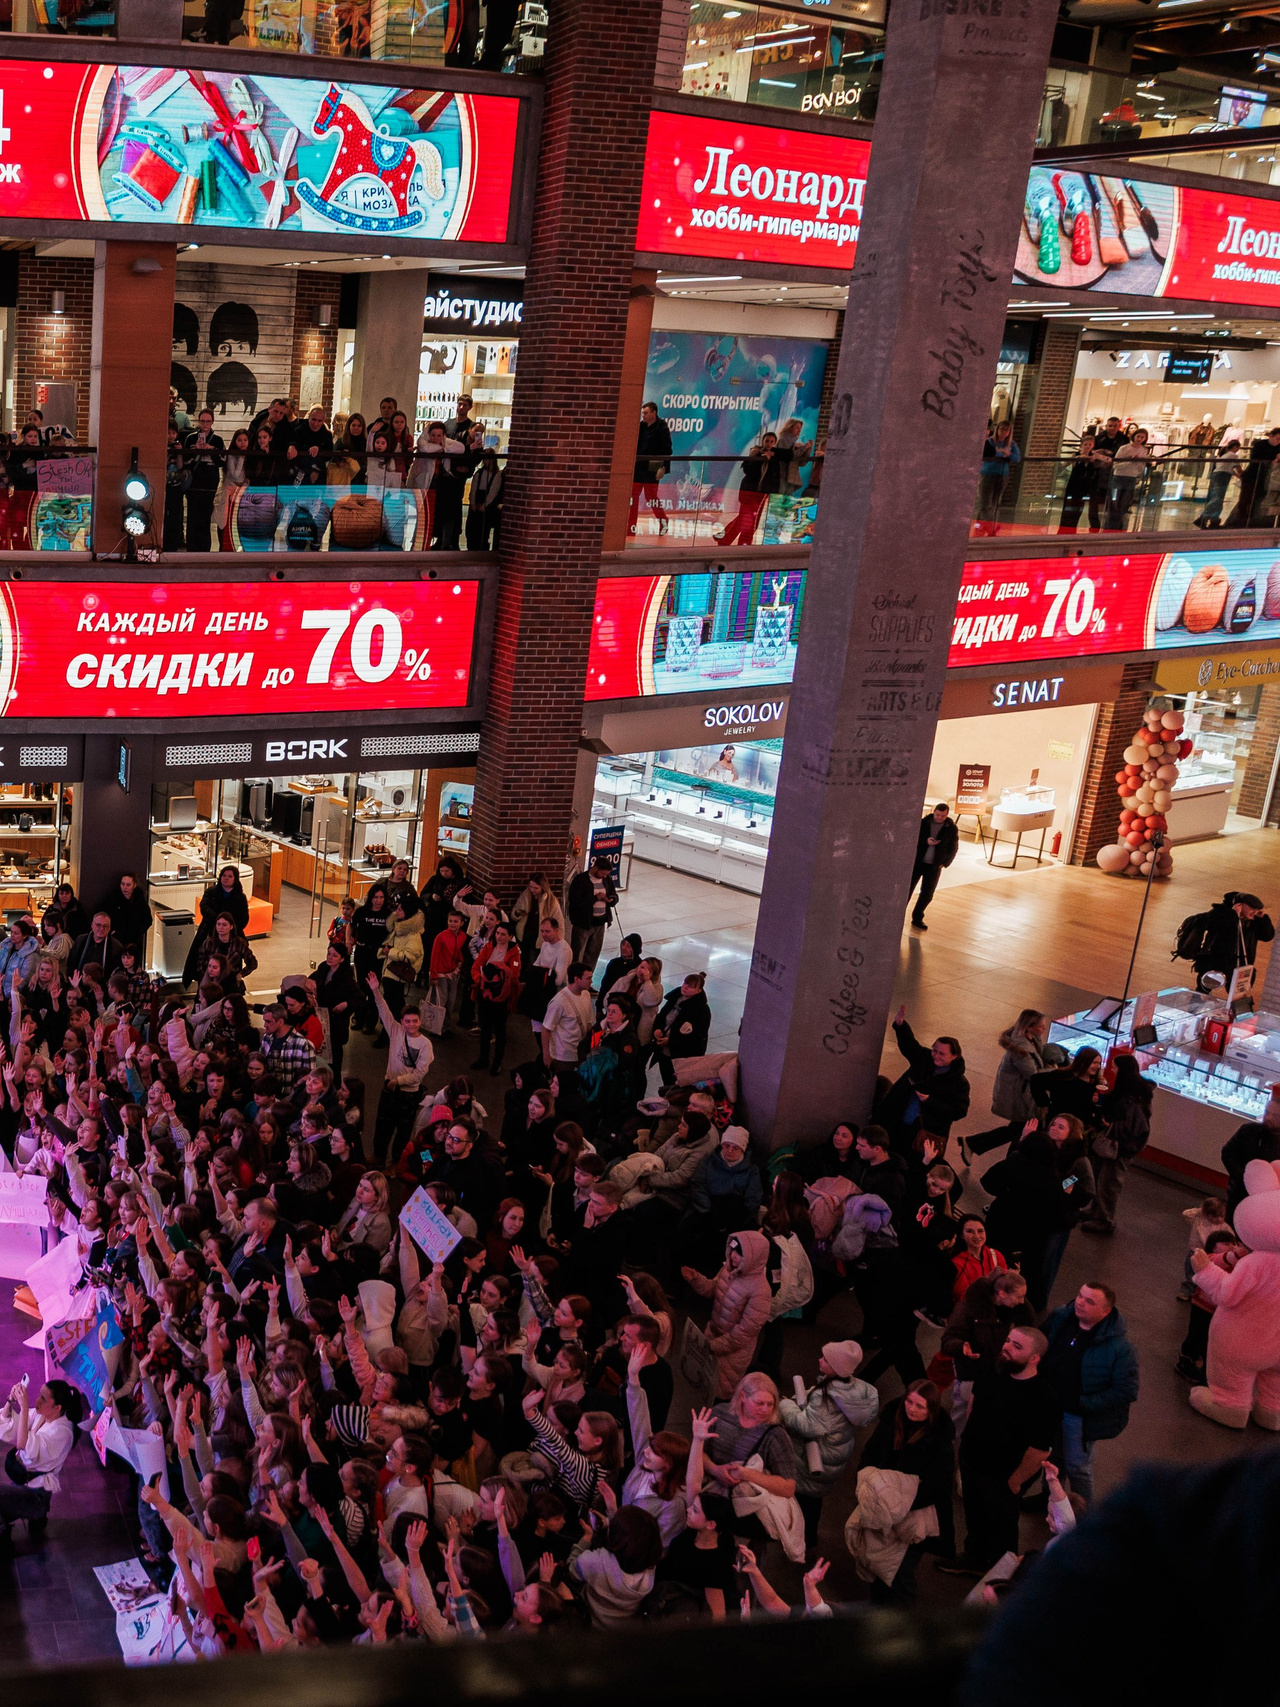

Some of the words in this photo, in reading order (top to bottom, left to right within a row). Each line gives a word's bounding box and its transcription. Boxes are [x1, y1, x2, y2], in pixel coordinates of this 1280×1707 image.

[1116, 352, 1233, 369] ZARA
[662, 393, 700, 409] СКОРО
[700, 395, 760, 411] ОТКРЫТИЕ
[996, 581, 1030, 601] ДЕНЬ
[76, 607, 196, 636] КАЖДЫЙ
[205, 611, 269, 636] ДЕНЬ
[869, 615, 935, 643] SUPPLIES
[951, 614, 1018, 650] ИДКИ
[1018, 624, 1037, 644] до
[66, 652, 254, 695] СКИДКИ
[261, 668, 295, 689] до
[992, 677, 1064, 708] SENAT
[704, 702, 785, 728] SOKOLOV
[723, 725, 756, 736] JEWELRY
[265, 738, 348, 762] BORK
[593, 831, 623, 840] СУПЕРЦЕНА
